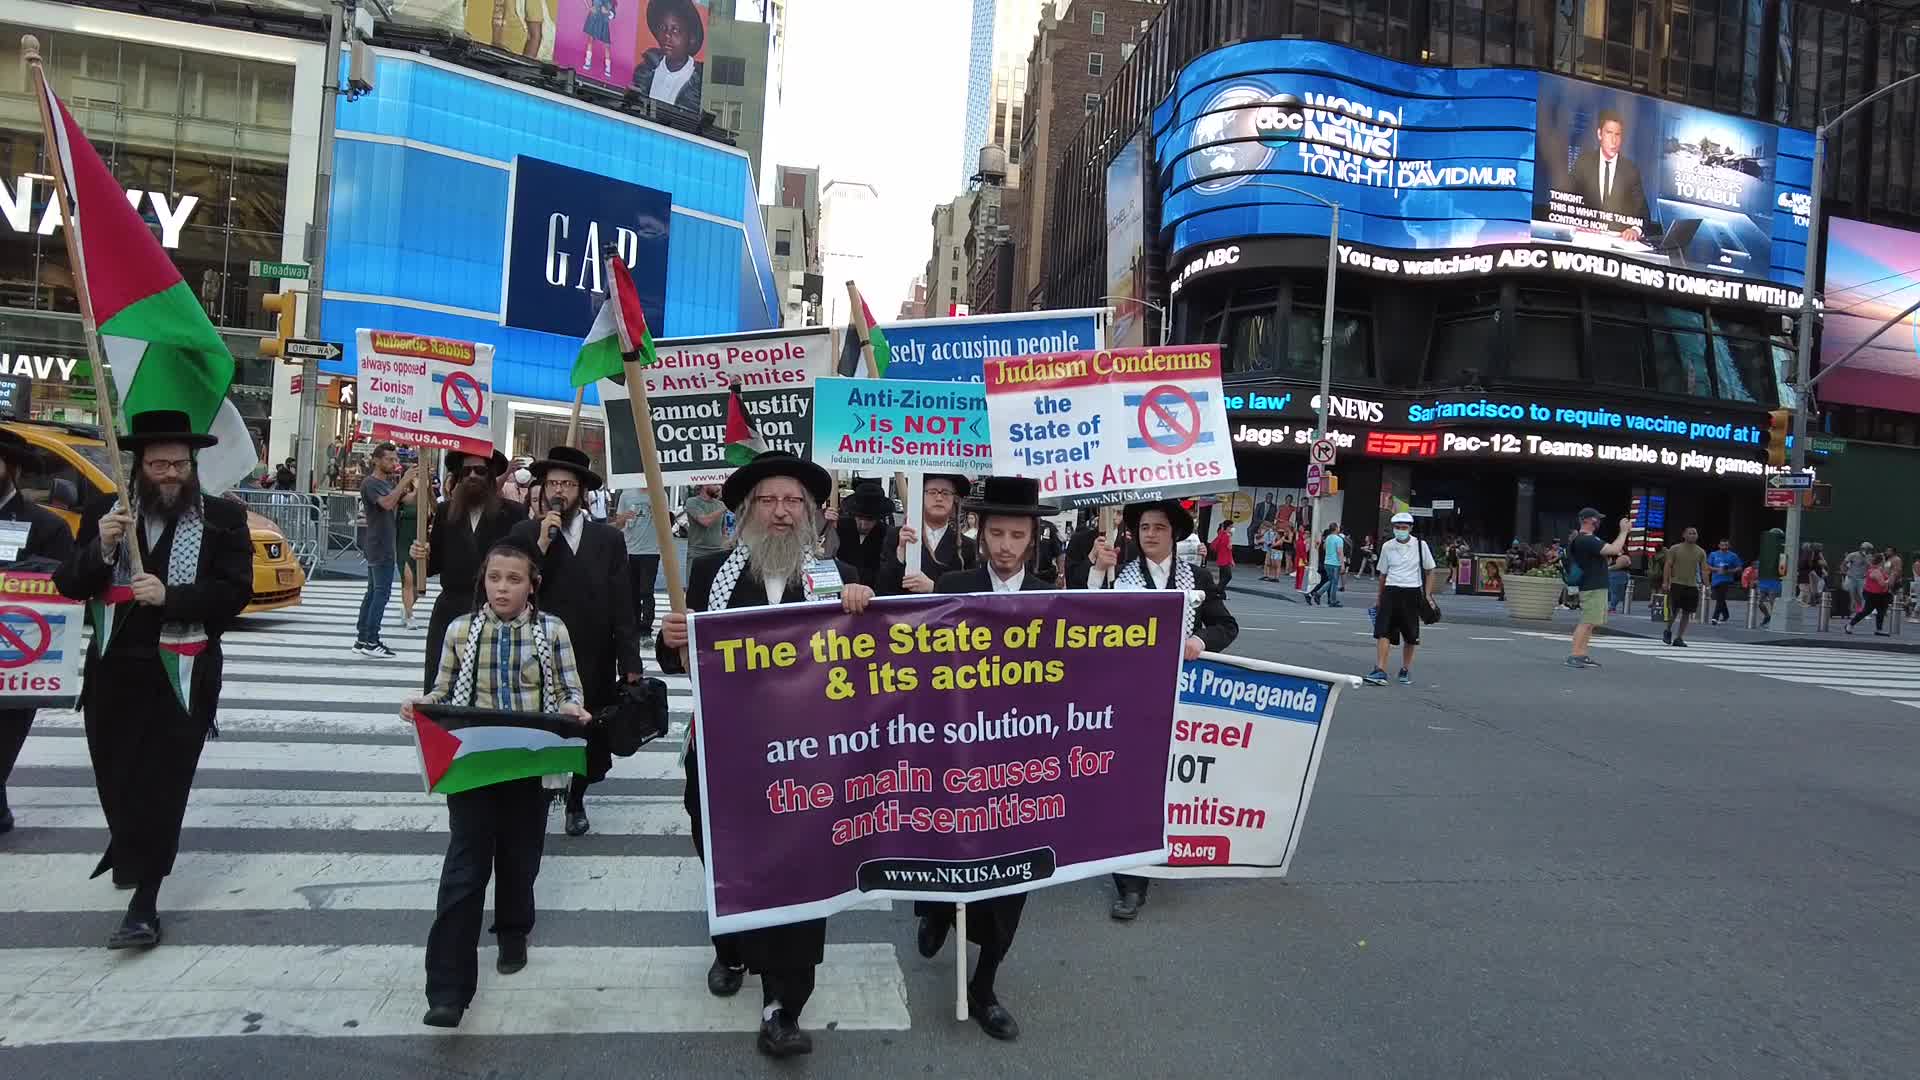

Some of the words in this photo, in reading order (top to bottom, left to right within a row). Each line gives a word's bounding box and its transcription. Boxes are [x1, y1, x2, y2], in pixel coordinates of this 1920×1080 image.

[1256, 109, 1303, 130] abc
[1304, 92, 1397, 138] WORLD
[1299, 121, 1392, 169] NEWS
[1299, 152, 1388, 187] TONIGHT
[1398, 168, 1468, 187] DAVID
[1399, 160, 1432, 171] WITH
[1550, 190, 1585, 205] TONIGHT.
[1675, 182, 1695, 198] TO
[1696, 186, 1741, 208] KABUL
[0, 176, 199, 249] NAY
[1549, 202, 1567, 213] THIS
[1567, 205, 1576, 215] IS
[1576, 207, 1599, 218] WHAT
[1599, 210, 1614, 221] THE
[1614, 213, 1644, 227] TALIBAN
[1549, 213, 1589, 229] CONTROLS
[546, 212, 638, 293] GAP
[1204, 245, 1240, 269] ABC
[262, 263, 307, 279] Broadway
[1337, 246, 1372, 267] You
[1373, 254, 1400, 273] are
[1403, 250, 1493, 276] watching
[1496, 249, 1548, 269] ABC
[1552, 251, 1619, 279] WORLD
[1620, 262, 1665, 290] NEWS
[1666, 272, 1743, 300] TONIGHT
[1745, 283, 1786, 306] WITH
[292, 344, 310, 354] ONE
[317, 346, 335, 356] WAY
[375, 334, 429, 353] Authentic
[431, 340, 471, 360] Rabbis
[727, 342, 806, 366] People
[932, 335, 1012, 361] accusing
[1018, 330, 1080, 353] people
[361, 356, 391, 374] always
[393, 361, 427, 377] opposed
[995, 356, 1088, 385] Judaism
[1093, 350, 1212, 376] Condemns
[370, 377, 414, 396] Zionism
[847, 387, 989, 412] Anti-Zionism
[362, 401, 388, 419] State
[389, 405, 399, 420] of
[400, 406, 423, 424] Israel
[744, 393, 810, 418] ustify
[1033, 396, 1072, 415] the
[1329, 395, 1384, 423] NEWS
[869, 413, 894, 434] is
[903, 413, 967, 435] NOT
[1009, 420, 1076, 442] State
[1078, 415, 1101, 438] of
[1529, 404, 1552, 421] to
[1555, 407, 1622, 429] require
[1625, 413, 1688, 435] vaccine
[1690, 421, 1731, 441] proof
[1733, 427, 1750, 442] at
[838, 434, 993, 458] Anti-Semitism
[1295, 427, 1356, 448] strter
[1367, 431, 1438, 456] ESPN
[1443, 432, 1522, 453] Pac-12:
[1526, 435, 1594, 458] Teams
[1598, 441, 1658, 465] unable
[1661, 448, 1679, 466] to
[1681, 449, 1714, 472] play
[1715, 456, 1764, 475] games
[831, 455, 860, 464] Judaism
[862, 456, 875, 464] and
[876, 456, 906, 465] Zionism
[920, 459, 969, 469] Diametrically
[970, 461, 992, 471] Oppos
[1065, 468, 1095, 490] its
[1101, 458, 1222, 486] Atrocities
[714, 638, 799, 674] The
[809, 629, 876, 668] the
[888, 621, 993, 656] State
[1003, 617, 1043, 649] of
[1054, 616, 1158, 650] Israel
[825, 667, 856, 701] &
[867, 661, 919, 696] its
[931, 656, 1065, 691] actions
[1200, 668, 1318, 713] Propaganda
[766, 734, 819, 764] are
[829, 723, 881, 756] not
[888, 714, 936, 747] the
[943, 706, 1060, 746] solution,
[1066, 702, 1114, 732] but
[1175, 719, 1254, 749] srael
[766, 777, 834, 815] the
[844, 760, 932, 806] main
[943, 752, 1061, 793] causes
[1068, 745, 1115, 778] for
[1169, 753, 1216, 784] OT
[831, 789, 1066, 848] anti-semitism
[1168, 796, 1266, 829] mitism
[883, 860, 1032, 884] www.NKUSA.org
